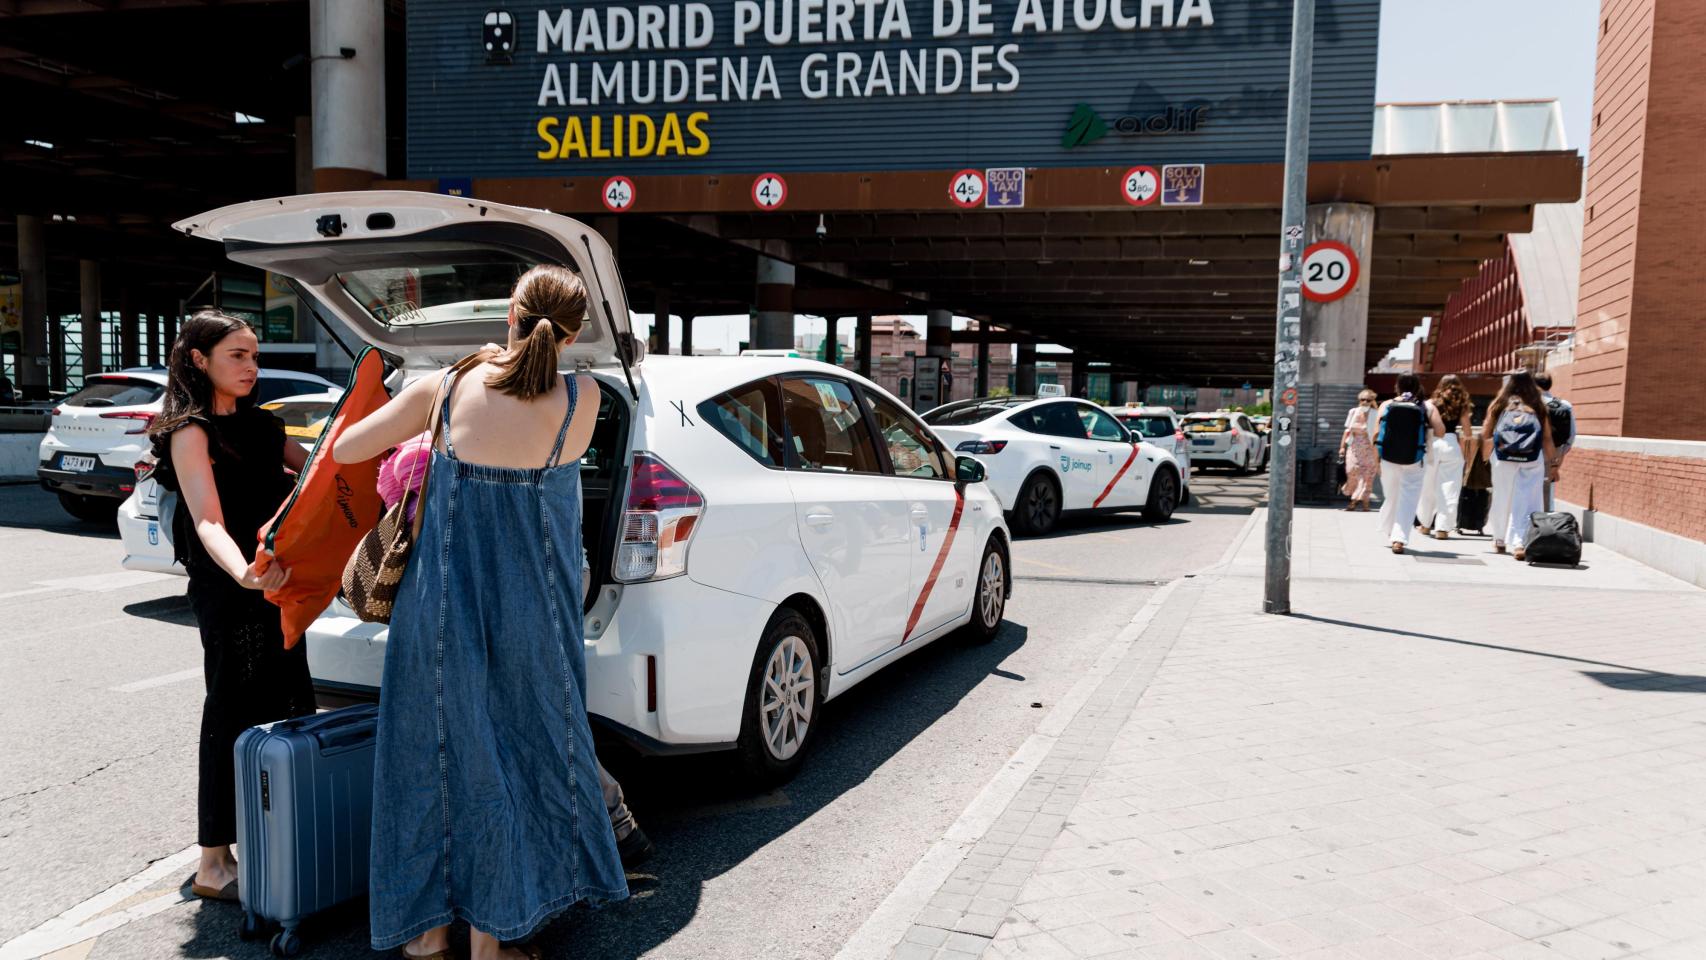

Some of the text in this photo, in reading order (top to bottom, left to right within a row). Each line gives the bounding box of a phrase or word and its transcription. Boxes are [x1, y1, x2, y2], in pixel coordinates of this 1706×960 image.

[537, 3, 714, 52] MADRID
[734, 0, 911, 46] PUERTA
[933, 0, 995, 37] DE
[537, 44, 1020, 106] ALMUDENA GRANDES
[1113, 105, 1210, 136] adif
[537, 112, 710, 159] SALIDAS
[989, 171, 1021, 182] SOLO
[1166, 167, 1200, 178] SOLO
[992, 181, 1018, 192] TAXI
[1169, 178, 1197, 190] TAXI
[1308, 261, 1344, 282] 20
[1071, 458, 1092, 473] joinup
